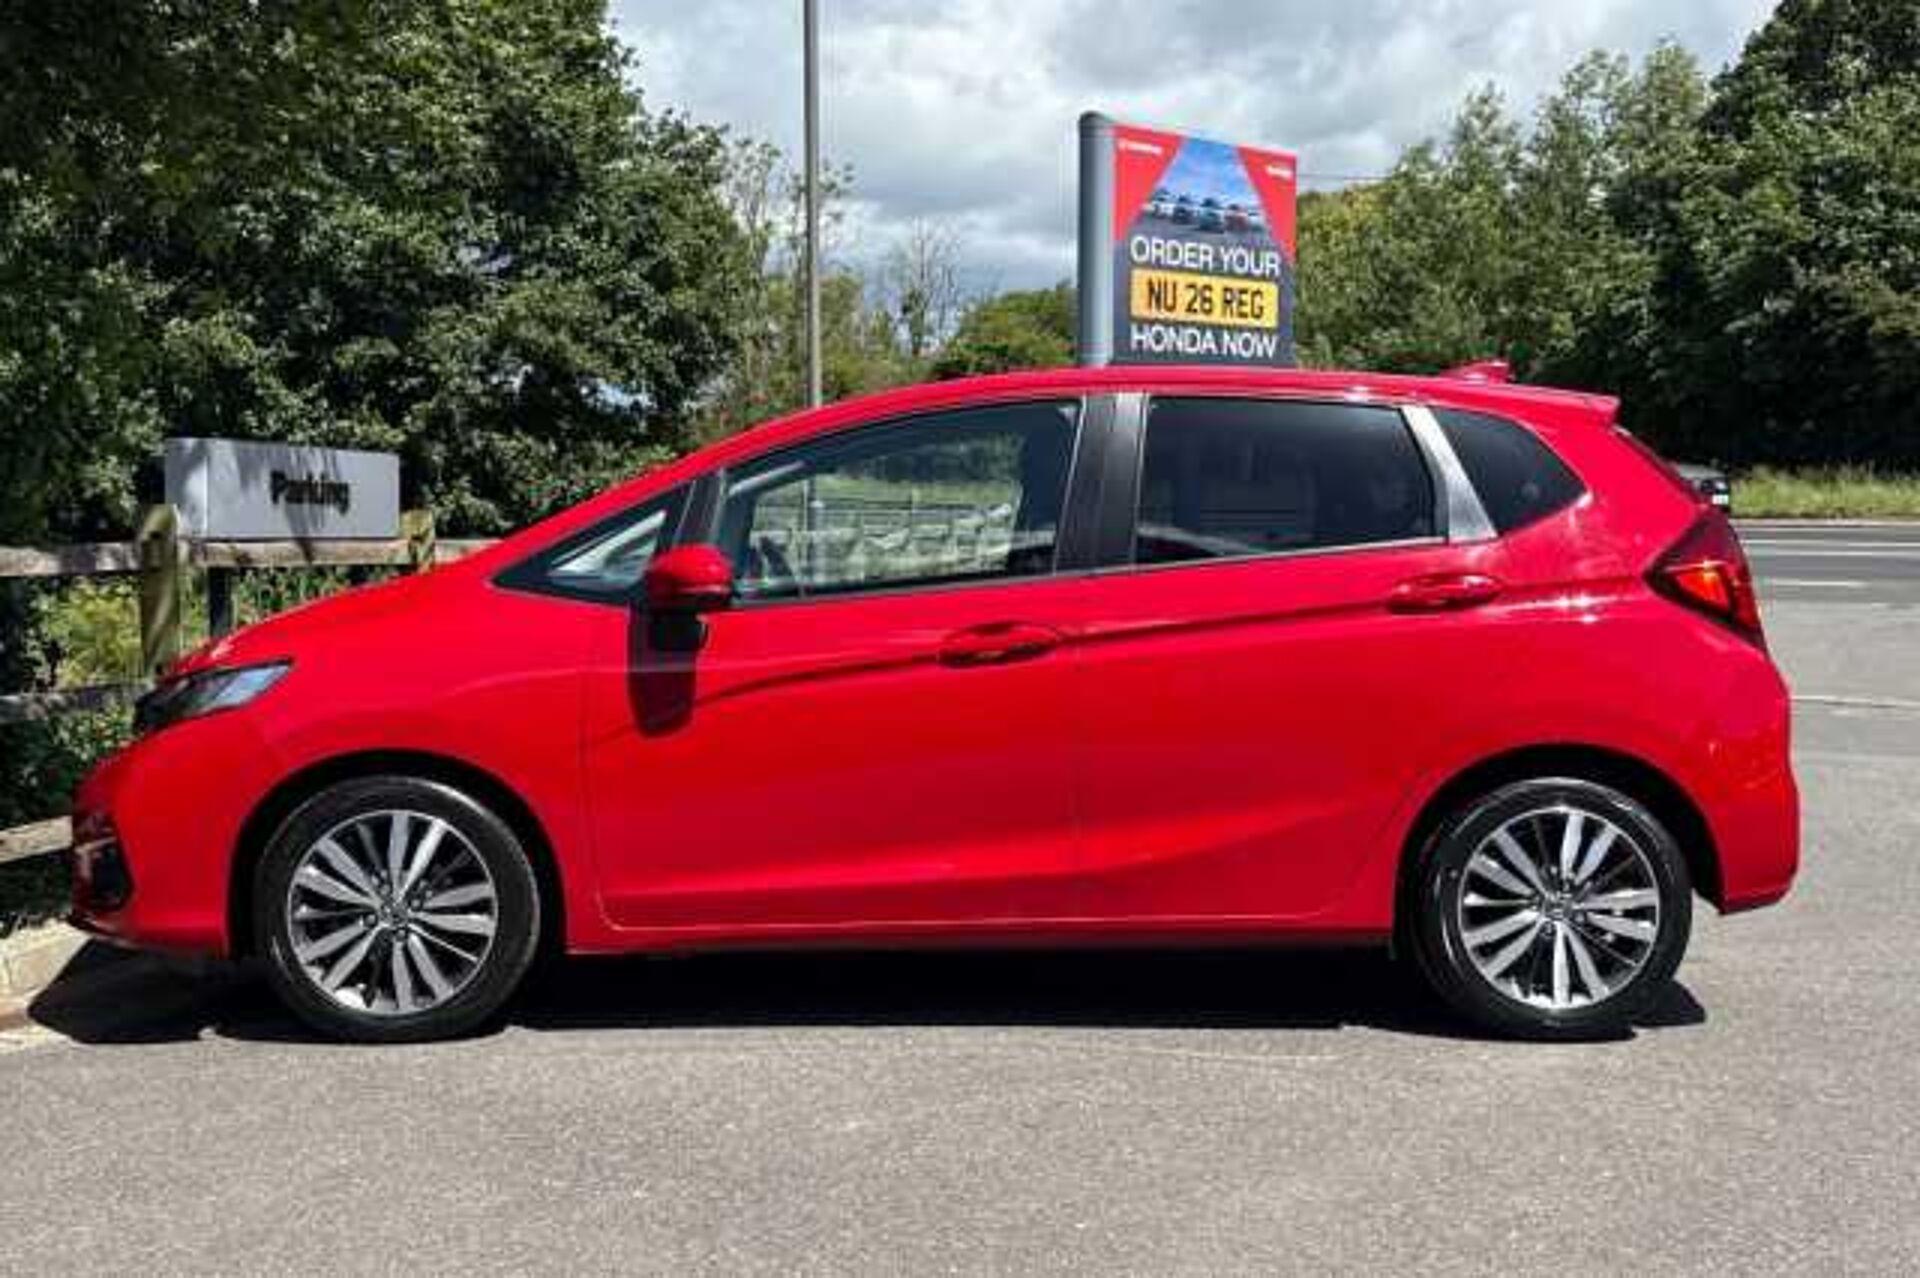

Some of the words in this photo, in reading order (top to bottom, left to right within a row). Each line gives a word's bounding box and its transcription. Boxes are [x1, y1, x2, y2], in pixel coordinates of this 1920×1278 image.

[1131, 236, 1213, 271] ORDER
[1220, 248, 1281, 277] YOUR
[1148, 278, 1178, 313] NU
[1185, 283, 1213, 316] 26
[1222, 287, 1265, 320] REG
[1131, 324, 1219, 355] HONDA
[1222, 332, 1279, 358] NOW
